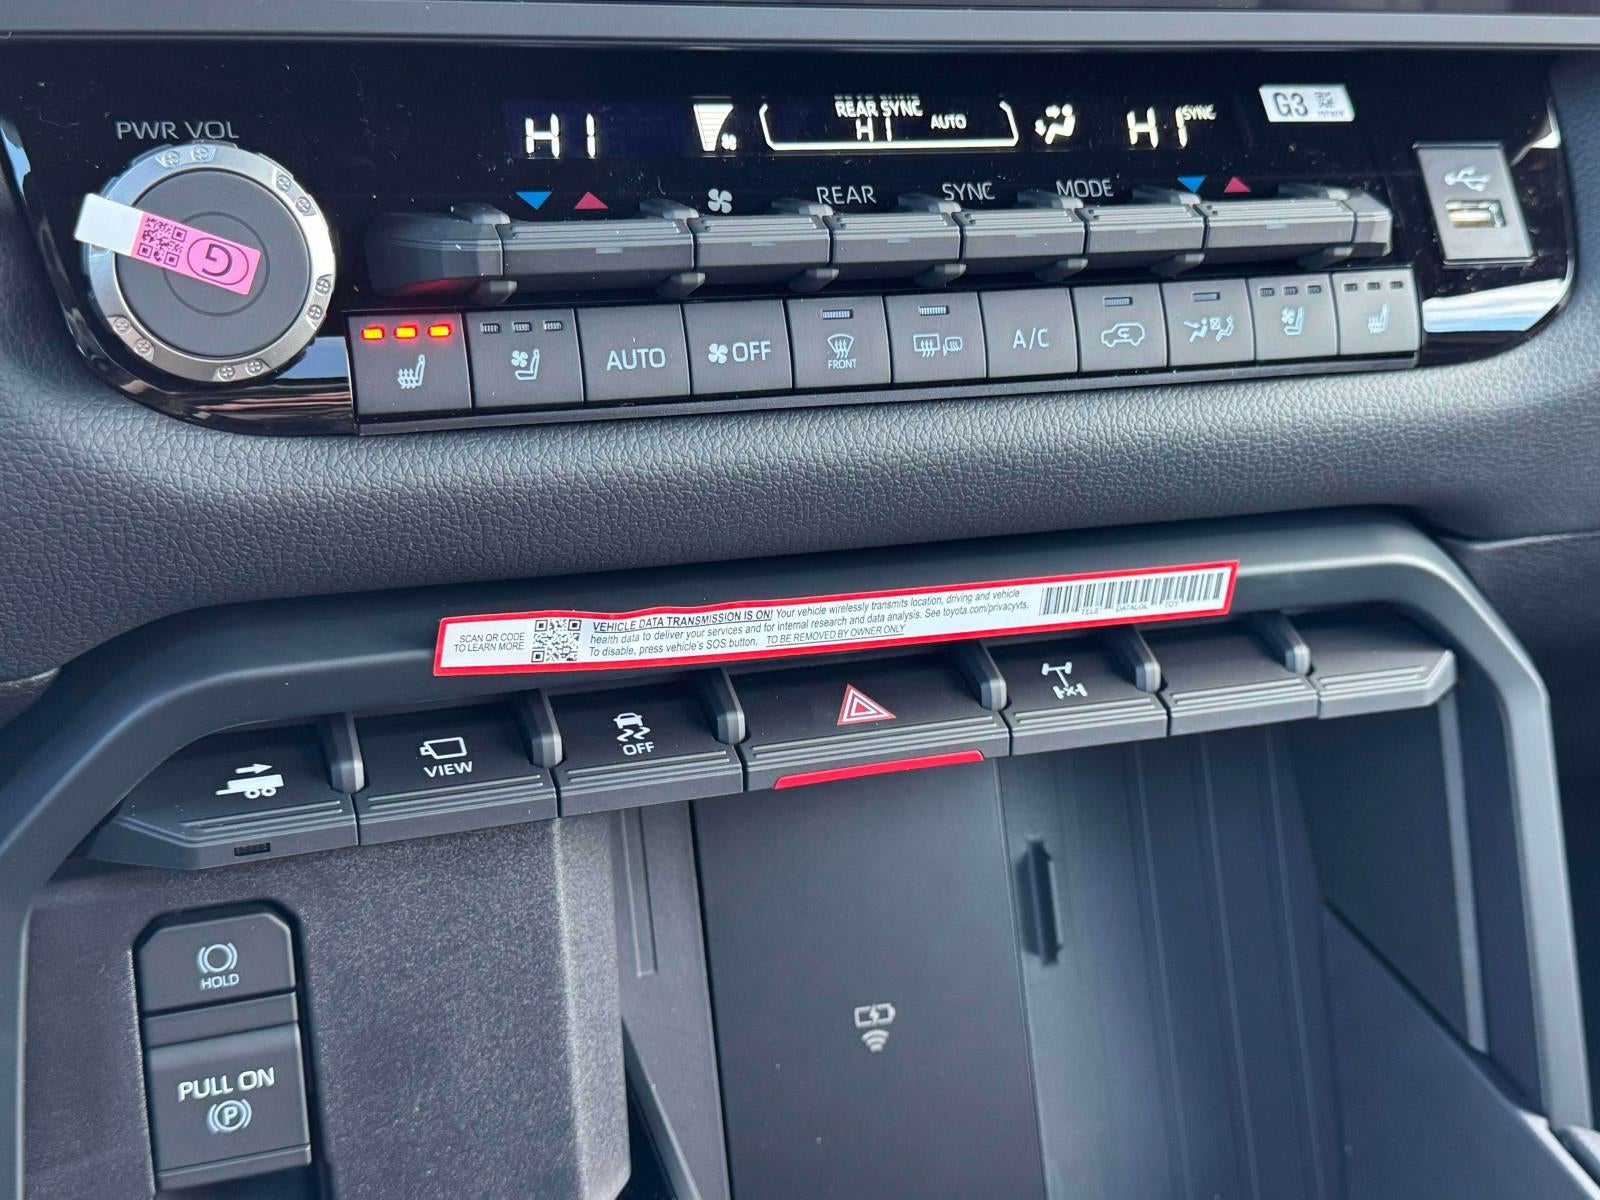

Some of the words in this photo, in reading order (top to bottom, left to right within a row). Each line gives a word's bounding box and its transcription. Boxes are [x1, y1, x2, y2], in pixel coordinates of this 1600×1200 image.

[834, 100, 879, 117] REAR
[880, 99, 923, 117] SYNC
[1183, 104, 1217, 120] SYNC
[1273, 92, 1308, 117] G3
[116, 121, 180, 140] PWR
[185, 120, 240, 138] VOL
[855, 117, 892, 142] HI
[930, 114, 967, 129] AUTO
[1126, 106, 1188, 148] HI
[525, 113, 596, 158] HI
[816, 185, 877, 205] REAR
[942, 182, 995, 201] SYNC
[1056, 179, 1114, 198] MODE
[201, 243, 233, 277] G
[1012, 328, 1050, 350] A/C
[606, 347, 666, 371] AUTO
[732, 341, 771, 363] OFF
[827, 358, 857, 369] FRONT
[592, 620, 636, 632] VEHICLE
[639, 618, 664, 629] DATA
[667, 611, 741, 626] TRANSMISSION
[744, 610, 753, 620] IS
[755, 609, 773, 619] ON!
[776, 608, 795, 618] Your
[797, 605, 826, 616] vehicle
[829, 600, 870, 614] wirelessly
[871, 599, 908, 610] transmits
[910, 595, 944, 607] location,
[946, 592, 973, 604] driving
[975, 590, 991, 601] and
[992, 588, 1020, 600] vehicle
[590, 633, 619, 644] health
[621, 633, 640, 643] data
[642, 632, 651, 641] to
[654, 630, 684, 641] deliver
[686, 629, 705, 640] your
[707, 625, 743, 637] services
[745, 623, 761, 634] and
[764, 622, 776, 632] for
[777, 619, 809, 631] internal
[810, 616, 847, 628] research
[849, 615, 865, 625] and
[867, 612, 885, 624] data
[887, 610, 922, 623] analysis.
[924, 608, 940, 618] See
[454, 643, 466, 652] TO
[467, 642, 496, 652] LEARN
[499, 641, 524, 651] MORE
[459, 634, 483, 643] SCAN
[485, 633, 499, 642] QR
[501, 632, 525, 641] CODE
[589, 646, 600, 656] To
[601, 646, 637, 657] disable,
[638, 644, 664, 656] press
[666, 641, 704, 653] vehicle's
[706, 638, 726, 650] SOS
[729, 637, 758, 648] button.
[767, 635, 778, 645] TO
[779, 634, 791, 643] BE
[793, 630, 837, 642] REMOVED
[838, 629, 849, 639] BY
[850, 626, 883, 637] OWNER
[883, 624, 906, 635] ONLY
[622, 741, 655, 755] OFF
[423, 761, 473, 778] VIEW
[200, 973, 240, 990] HOLD
[177, 1074, 234, 1102] PULL
[238, 1066, 275, 1092] ON
